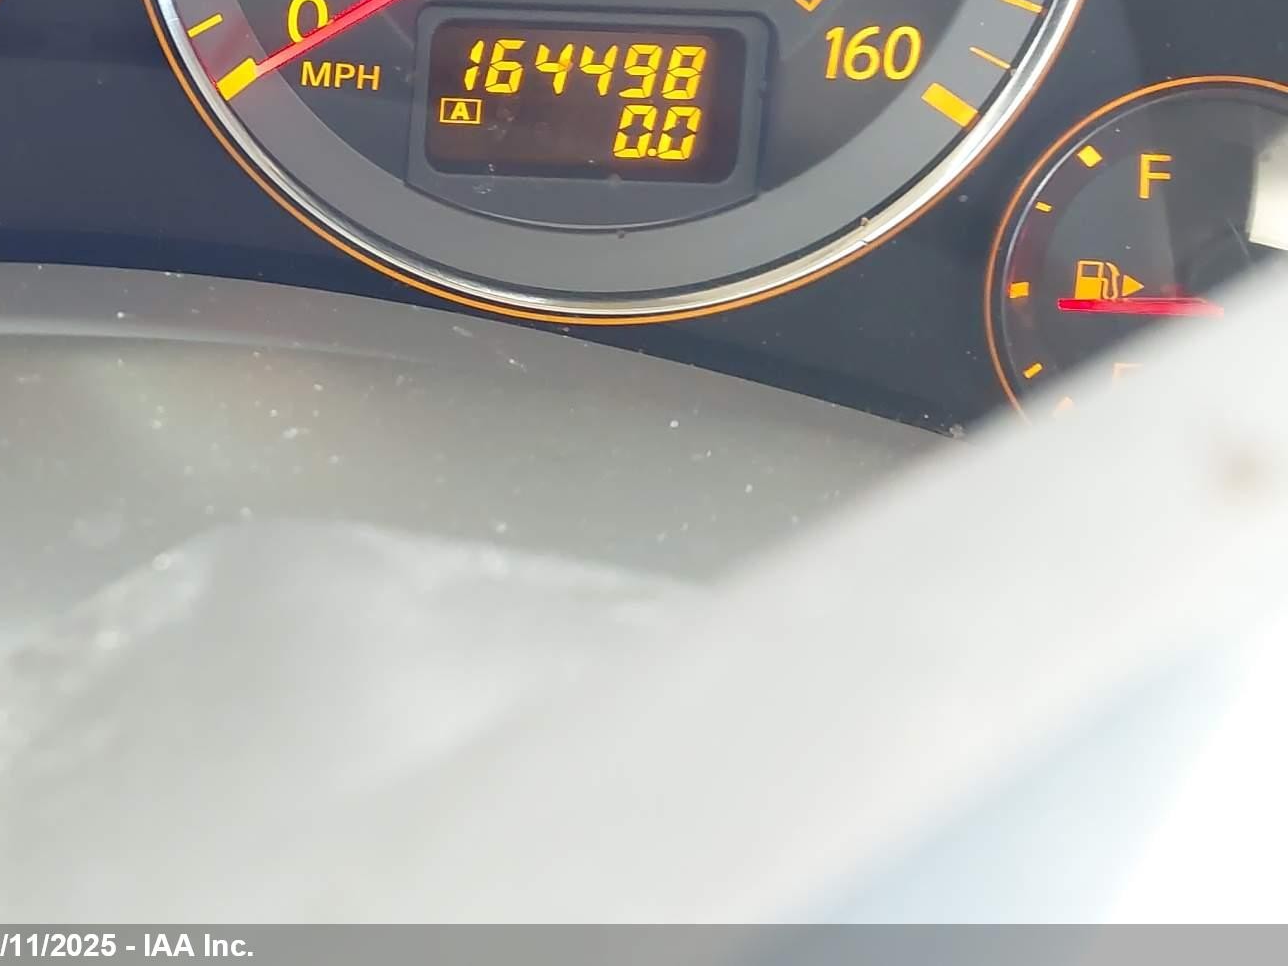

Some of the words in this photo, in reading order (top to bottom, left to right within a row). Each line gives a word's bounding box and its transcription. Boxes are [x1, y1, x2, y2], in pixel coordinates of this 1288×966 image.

[300, 60, 381, 91] MPH
[463, 38, 708, 100] 164498
[824, 26, 922, 81] 160
[613, 103, 701, 160] 0.0
[1138, 153, 1173, 200] F
